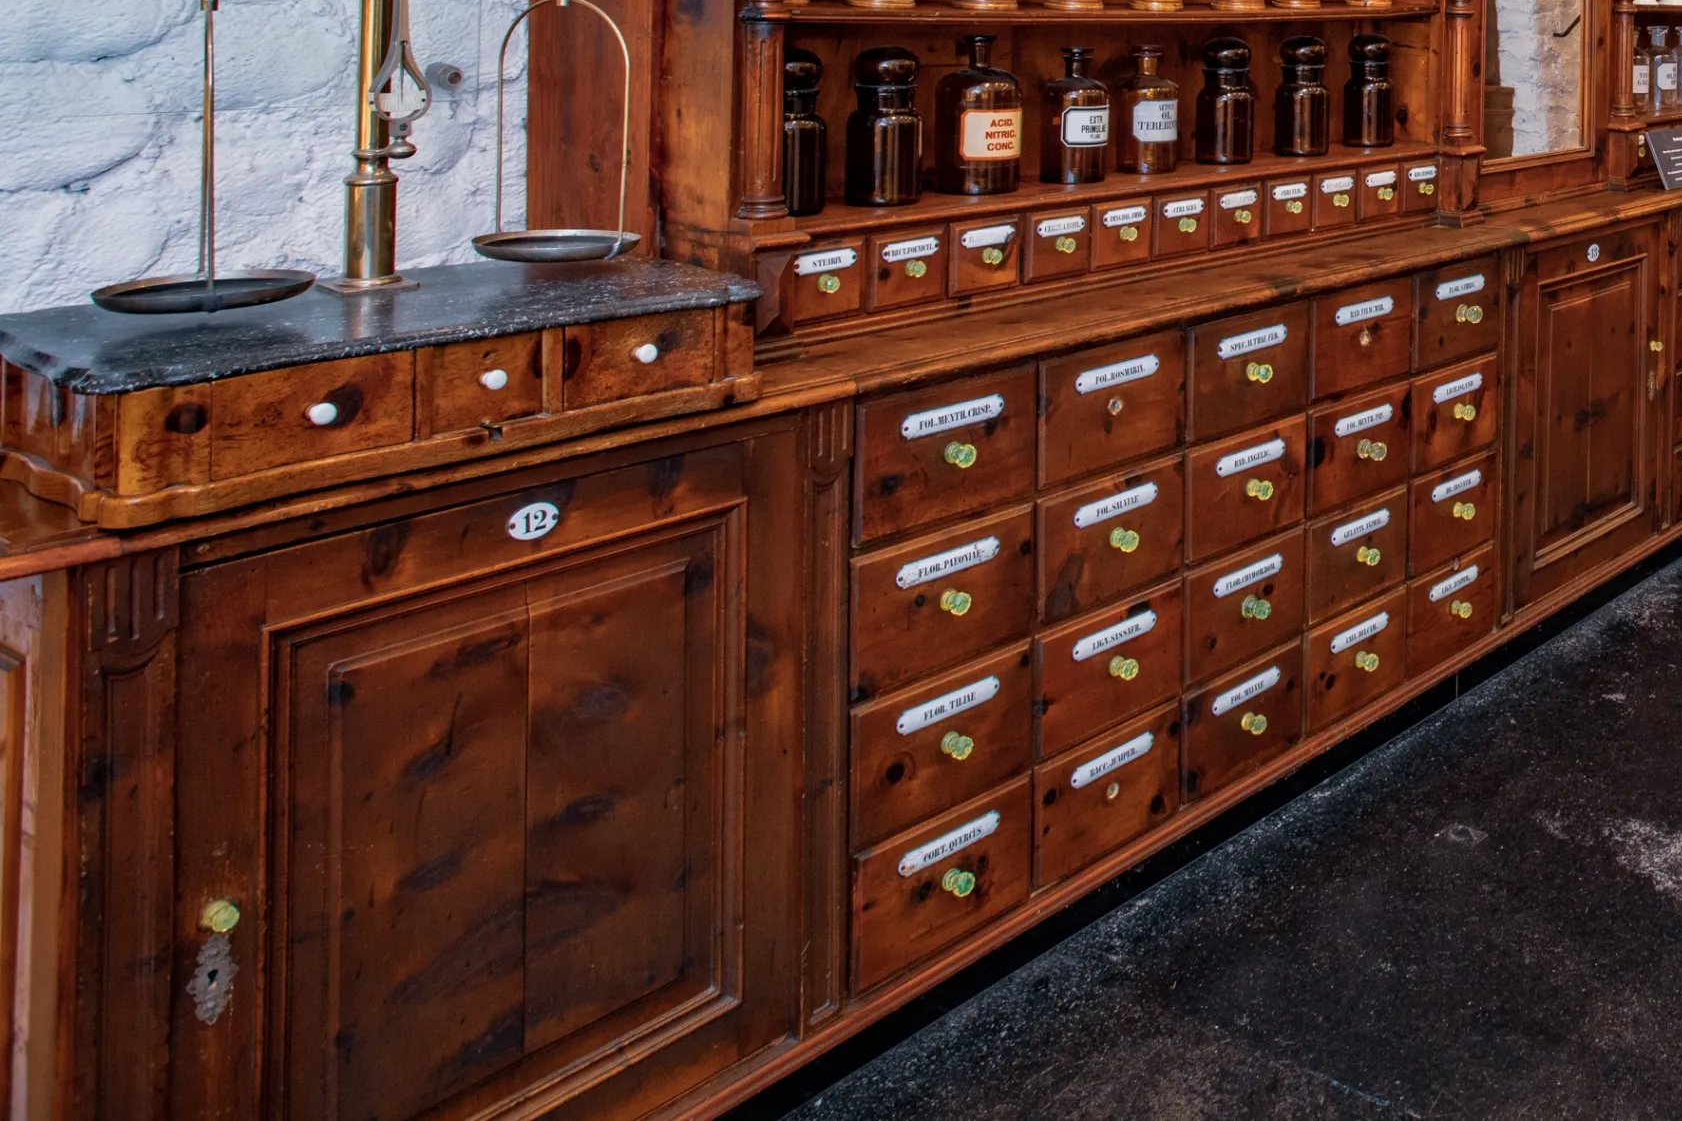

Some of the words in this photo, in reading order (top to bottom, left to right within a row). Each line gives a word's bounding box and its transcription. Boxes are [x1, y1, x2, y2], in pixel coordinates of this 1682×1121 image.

[990, 119, 1014, 127] ACID.
[985, 130, 1016, 140] NITRIC.
[986, 142, 1015, 151] CONC.
[522, 510, 547, 535] 12
